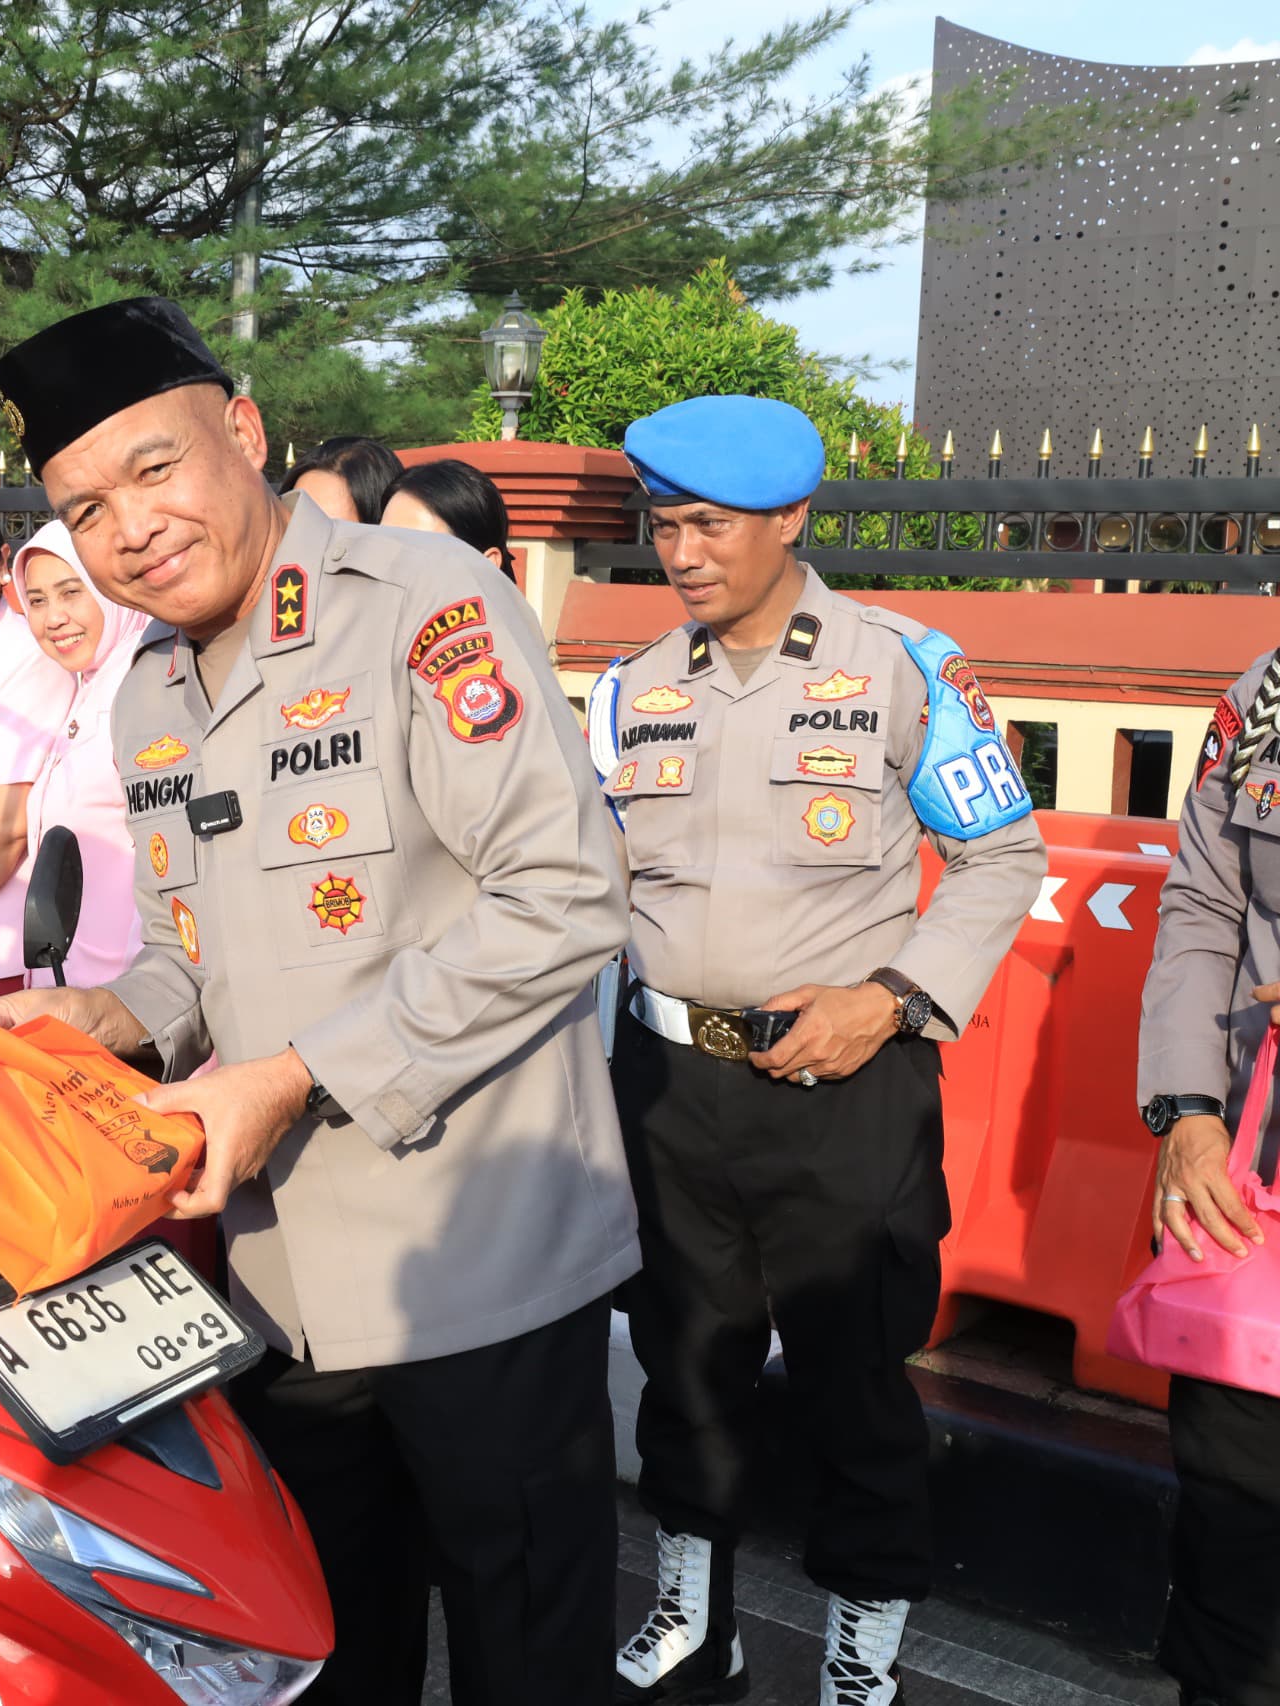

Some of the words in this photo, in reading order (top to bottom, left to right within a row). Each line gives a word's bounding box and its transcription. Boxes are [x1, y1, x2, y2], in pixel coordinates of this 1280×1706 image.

[411, 602, 480, 662] POLDA
[426, 637, 486, 675] BANTEN
[789, 709, 878, 733] POLRI
[270, 730, 362, 782] POLRI
[126, 772, 194, 815] HENGKI
[933, 741, 1028, 828] PR
[26, 1284, 128, 1352] 6636
[129, 1253, 195, 1306] AE
